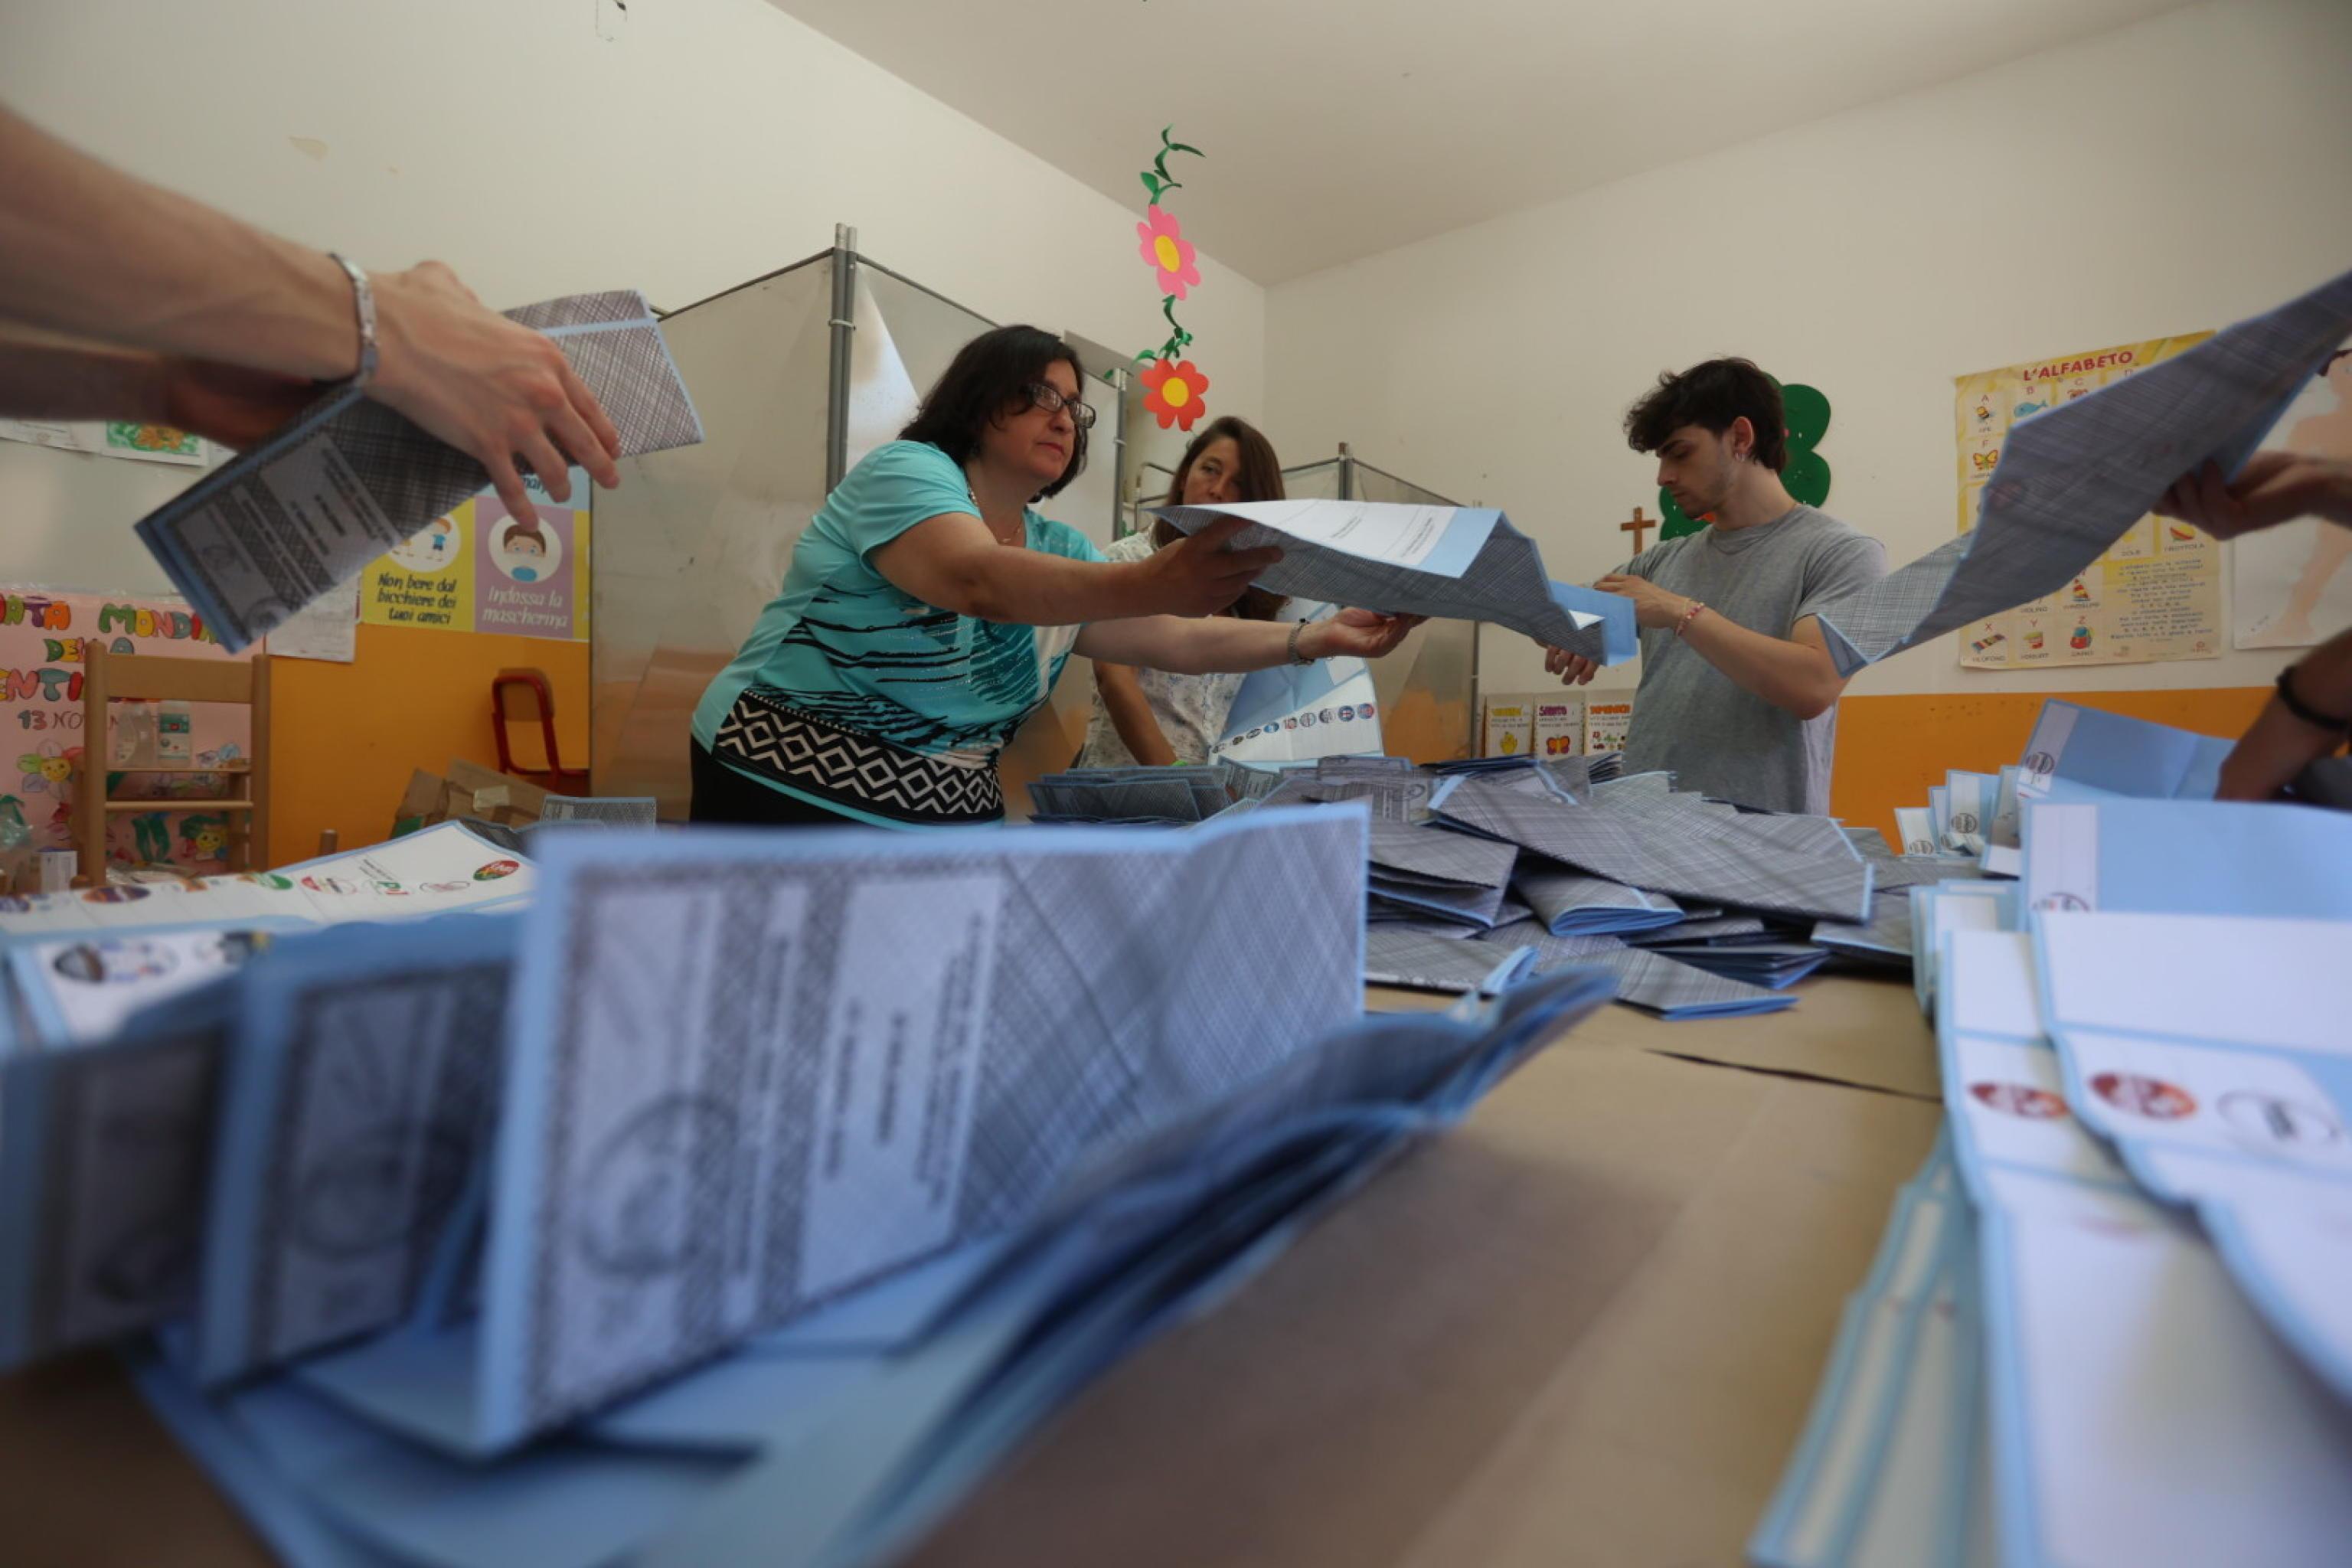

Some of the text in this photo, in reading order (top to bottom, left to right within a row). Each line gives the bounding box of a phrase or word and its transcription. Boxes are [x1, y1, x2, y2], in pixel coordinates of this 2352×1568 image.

[2023, 351, 2133, 381] L'ALFABETO
[377, 573, 457, 593] Non bere dal
[377, 588, 456, 609] bicchiere dei
[488, 586, 564, 608] Indossa la
[0, 593, 71, 630] ATA
[388, 607, 451, 625] tuoi amici
[482, 606, 569, 629] mascherina
[0, 668, 84, 702] ENTI
[18, 709, 47, 730] 13
